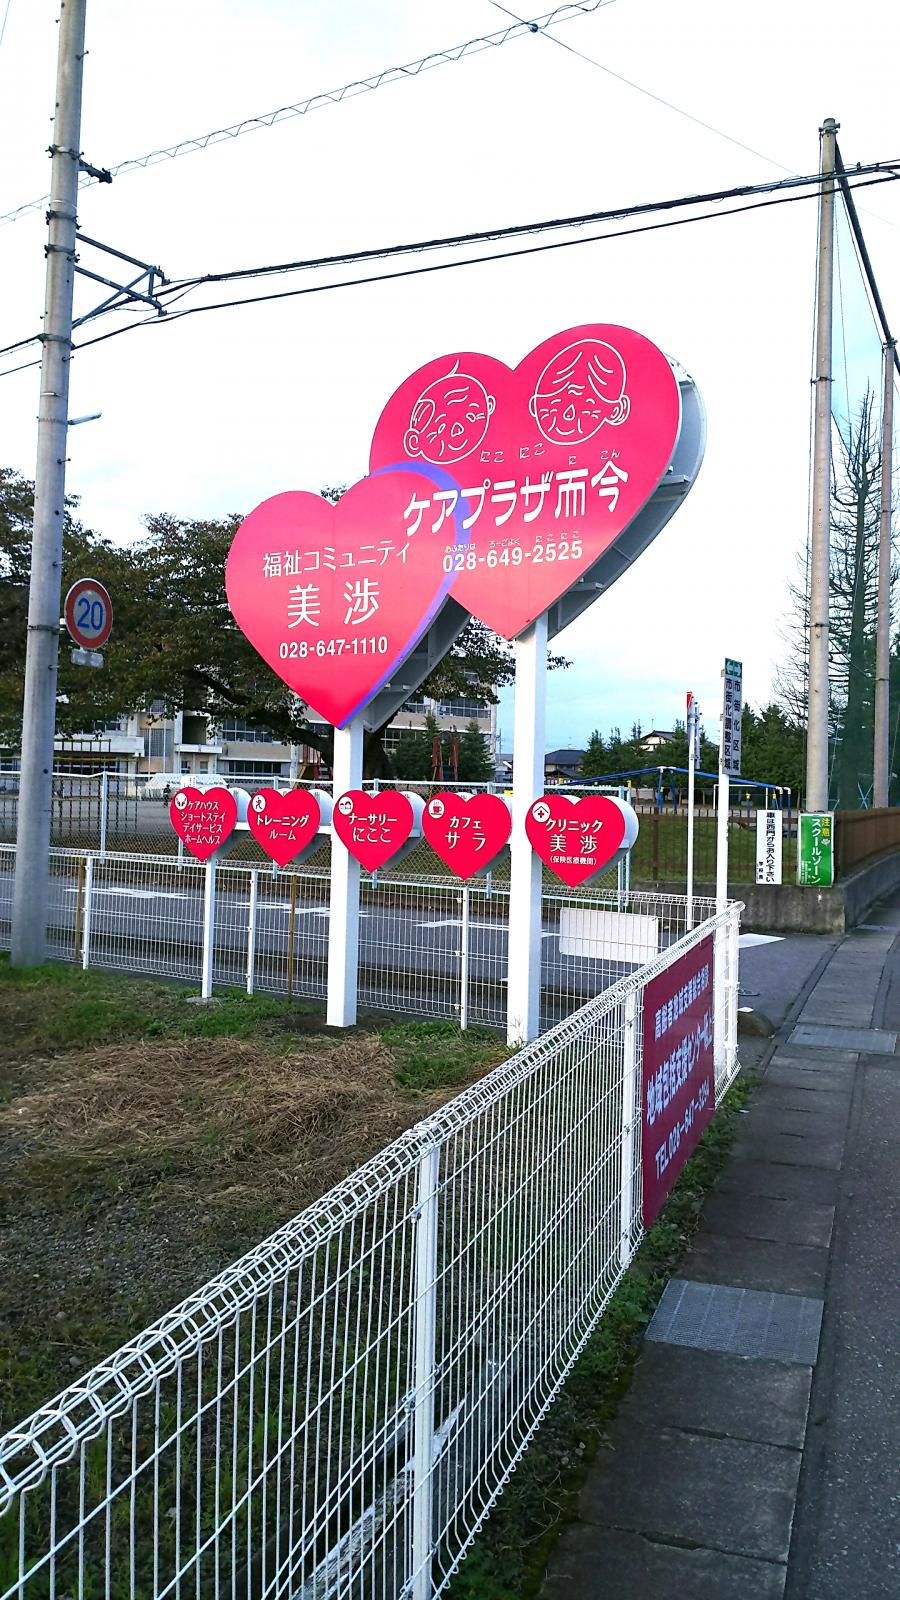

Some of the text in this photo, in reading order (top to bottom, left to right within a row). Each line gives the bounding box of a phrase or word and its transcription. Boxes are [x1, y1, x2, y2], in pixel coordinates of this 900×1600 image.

[480, 442, 545, 463] にこ にこ
[404, 460, 628, 536] ケアプラザ而今
[262, 539, 411, 579] 福祉コミュニティ
[443, 540, 583, 572] 028-649-2525
[77, 597, 104, 631] 20
[279, 636, 388, 659] 028-647-1110
[187, 800, 219, 811] ケアハウス
[181, 811, 226, 822] ショートステイ
[256, 814, 309, 828] トレーニング
[348, 813, 398, 827] ナーサリー
[448, 816, 482, 830] カフェ
[183, 822, 223, 833] デイサービス
[545, 818, 603, 834] クリニック
[269, 830, 297, 841] ルーム
[352, 828, 392, 843] にここ
[811, 818, 822, 884] スクールゾーン
[655, 1140, 669, 1180] TEL
